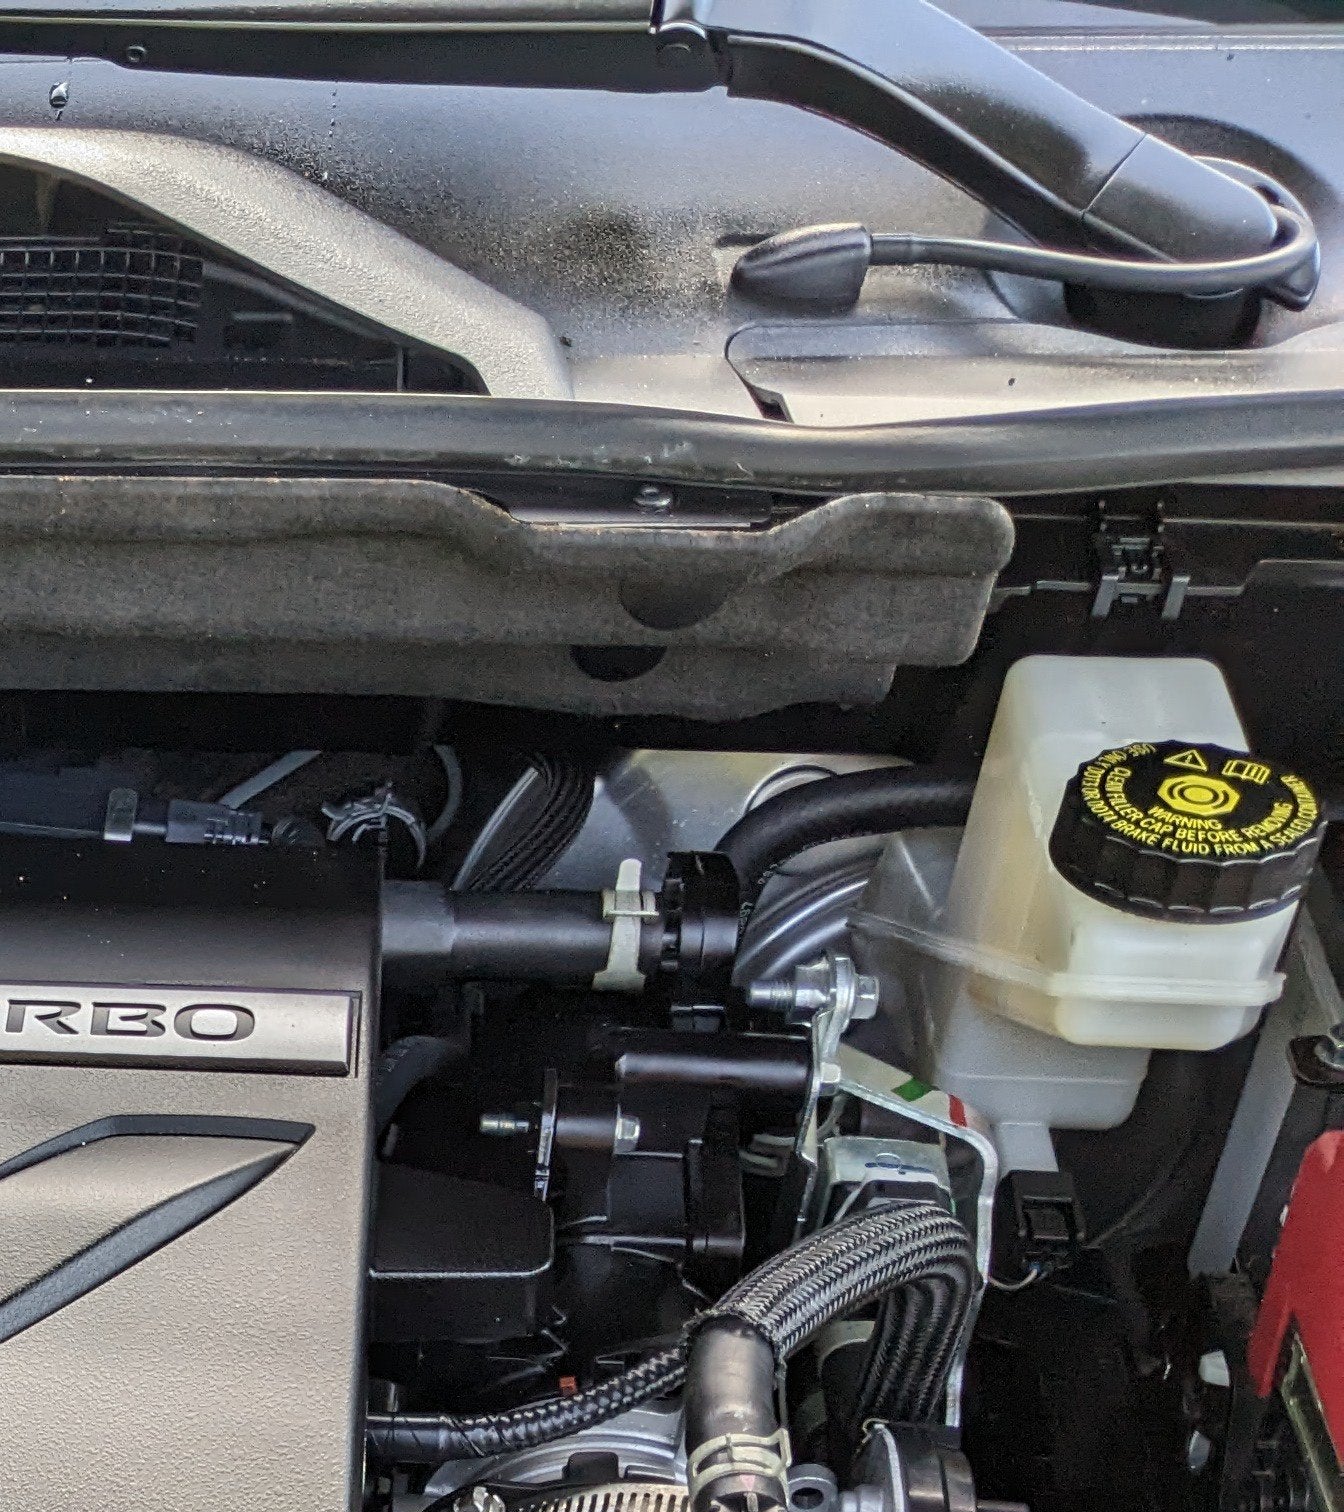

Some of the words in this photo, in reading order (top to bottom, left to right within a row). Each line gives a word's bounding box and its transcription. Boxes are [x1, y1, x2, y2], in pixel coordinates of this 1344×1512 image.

[1106, 792, 1144, 822] FILLER
[1139, 818, 1174, 834] CAP
[1175, 828, 1243, 843] BEFORE
[1241, 802, 1293, 839] REMOVING
[1147, 806, 1222, 830] WARNING
[1110, 819, 1161, 846] BRAKE
[1161, 837, 1210, 855] FLUID
[1213, 841, 1261, 857] FROM
[1259, 839, 1274, 850] A
[1269, 819, 1313, 846] SEALED
